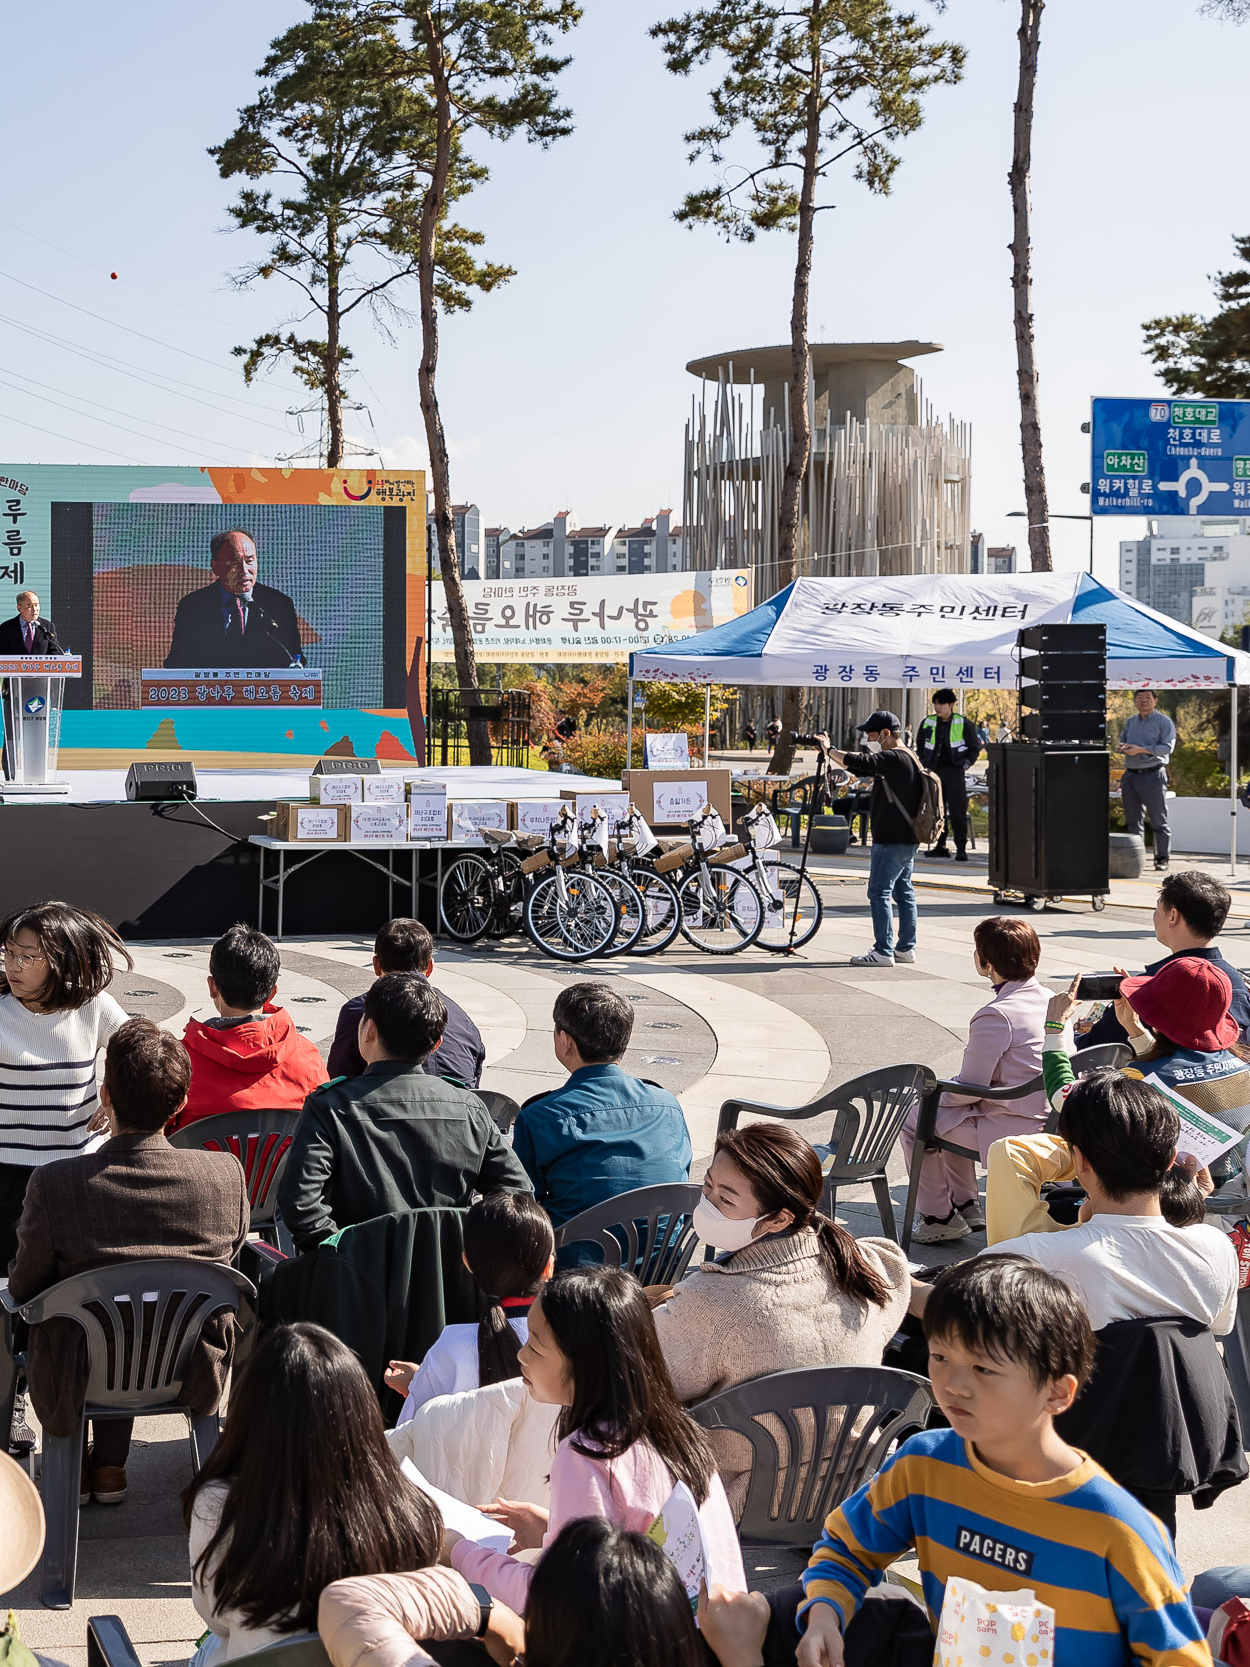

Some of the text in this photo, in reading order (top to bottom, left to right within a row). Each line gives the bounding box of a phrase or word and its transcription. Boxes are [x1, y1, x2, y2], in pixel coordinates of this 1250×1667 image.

[1153, 407, 1166, 419] 70
[1172, 406, 1217, 422] 천호대교
[1167, 428, 1222, 445] 천호대로
[1106, 455, 1144, 471] 아차산
[376, 487, 415, 502] 행복광진
[1097, 479, 1154, 497] 워커힐로
[1098, 497, 1153, 507] Walkerhill-ro
[820, 602, 1029, 621] 광장동주민센터
[812, 664, 1001, 683] 광장동 주민센터
[149, 685, 315, 701] 2023 광나루 해오름 축제
[1172, 1066, 1205, 1080] 광장동
[959, 1530, 1028, 1571] PACERS
[976, 1626, 998, 1635] corn
[977, 1618, 997, 1628] POP
